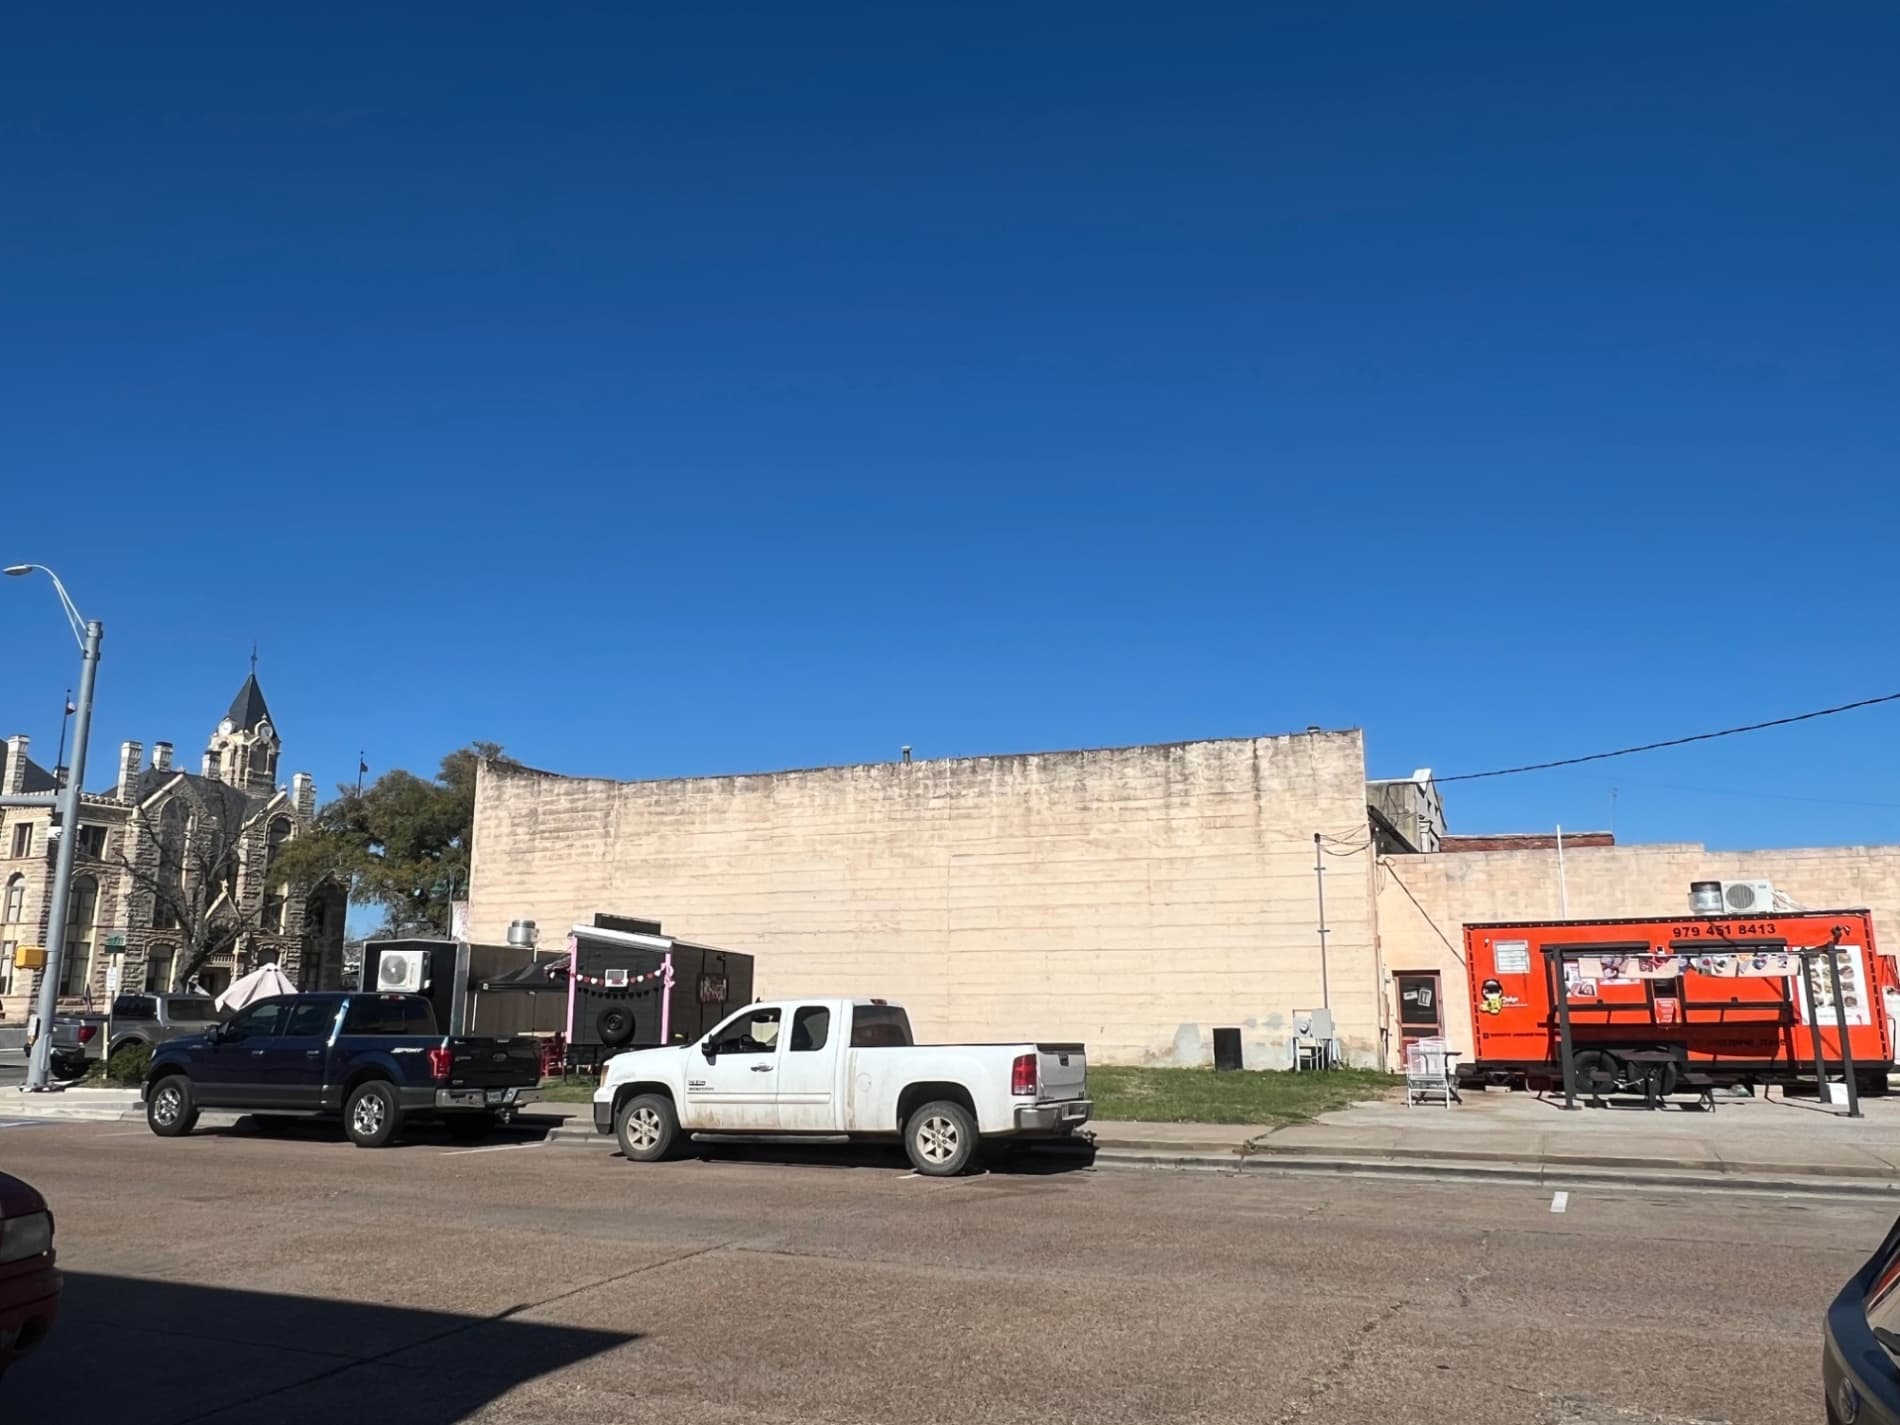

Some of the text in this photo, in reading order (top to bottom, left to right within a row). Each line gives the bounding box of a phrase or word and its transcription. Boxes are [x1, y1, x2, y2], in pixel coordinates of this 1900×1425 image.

[1673, 923, 1776, 938] 979 451 8413
